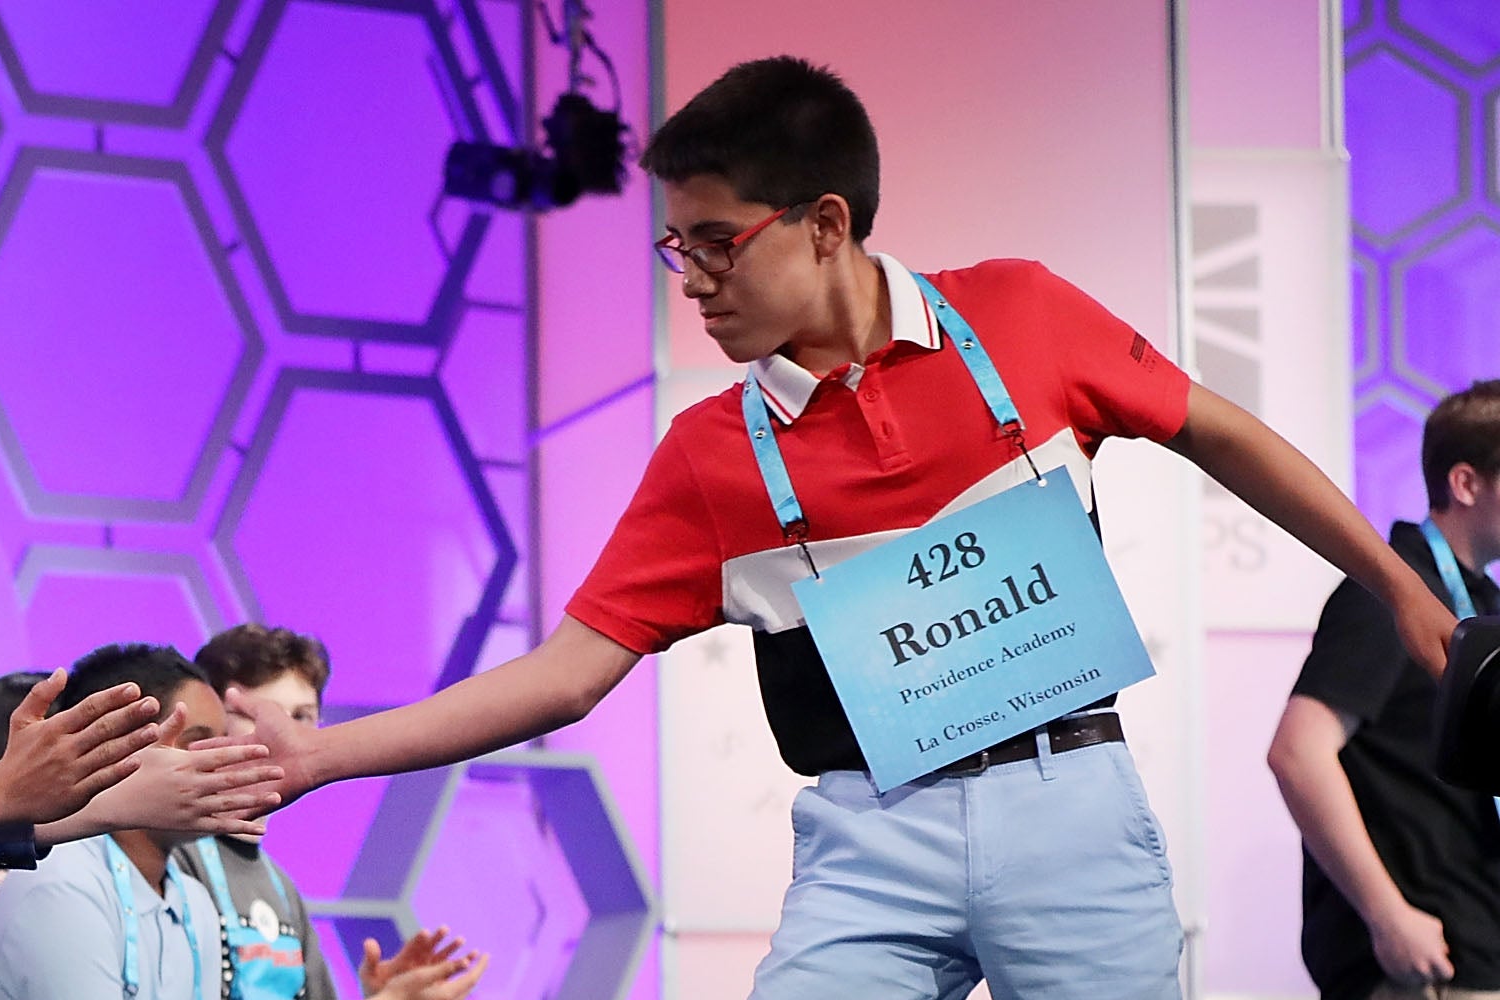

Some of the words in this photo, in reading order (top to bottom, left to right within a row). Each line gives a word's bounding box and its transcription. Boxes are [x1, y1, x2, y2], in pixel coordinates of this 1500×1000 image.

[906, 532, 986, 590] 428
[879, 563, 1058, 667] Ronald
[900, 657, 996, 705] Providence
[1001, 622, 1077, 663] Academy
[914, 735, 940, 753] La
[943, 705, 1006, 741] Crosse,
[1007, 665, 1102, 714] Wisconsin
